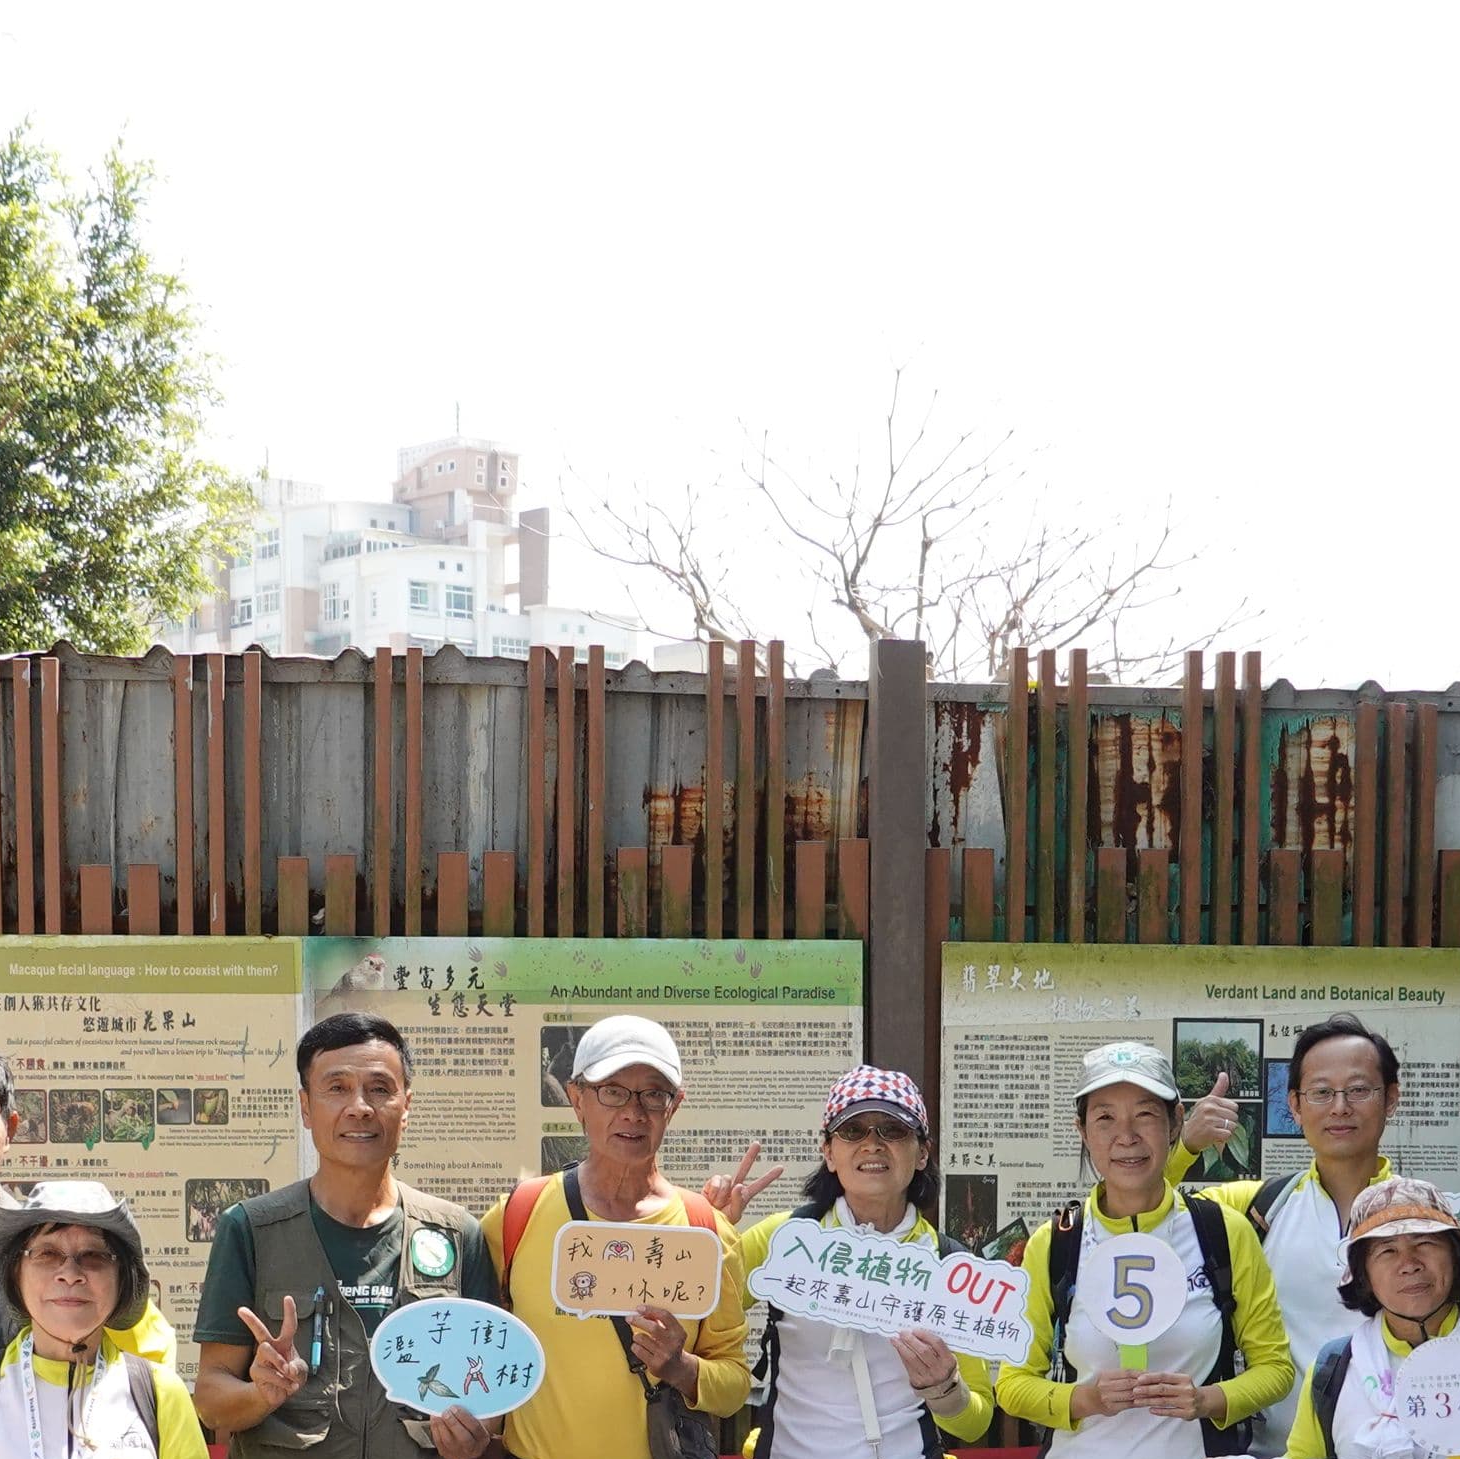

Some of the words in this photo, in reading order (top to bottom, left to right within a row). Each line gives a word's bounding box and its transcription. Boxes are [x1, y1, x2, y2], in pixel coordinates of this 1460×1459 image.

[9, 963, 55, 978] Macaque
[58, 963, 85, 976] facial
[88, 963, 135, 978] language
[139, 966, 142, 976] :
[145, 964, 166, 976] How
[170, 965, 181, 976] to
[183, 964, 219, 976] coexist
[222, 964, 244, 977] with
[247, 964, 278, 977] them?
[392, 964, 485, 991] 豐富多元
[962, 964, 1055, 993] 翡翠大地
[428, 991, 518, 1018] 生態天堂
[550, 985, 568, 998] An
[571, 985, 633, 999] Abundant
[636, 985, 660, 999] and
[664, 986, 710, 999] Diverse
[714, 986, 778, 1001] Ecological
[782, 986, 835, 1000] Paradise
[1205, 984, 1258, 1000] Verdant
[1262, 985, 1297, 1000] Land
[1300, 986, 1325, 1001] and
[1329, 987, 1391, 1001] Botanical
[1398, 988, 1446, 1005] Beauty
[82, 1016, 137, 1033] 悠遊城市
[142, 1011, 196, 1032] 花果山
[403, 1160, 446, 1171] Something
[447, 1160, 469, 1170] about
[471, 1161, 503, 1170] Animals
[1025, 1161, 1045, 1169] Beauty
[568, 1233, 593, 1263] 我
[645, 1236, 692, 1269] 壽山
[782, 1236, 932, 1291] 入侵植物
[946, 1261, 1017, 1315] OUT
[1106, 1254, 1155, 1330] 5
[763, 1273, 1021, 1342] 一起來壽山守護原生植物
